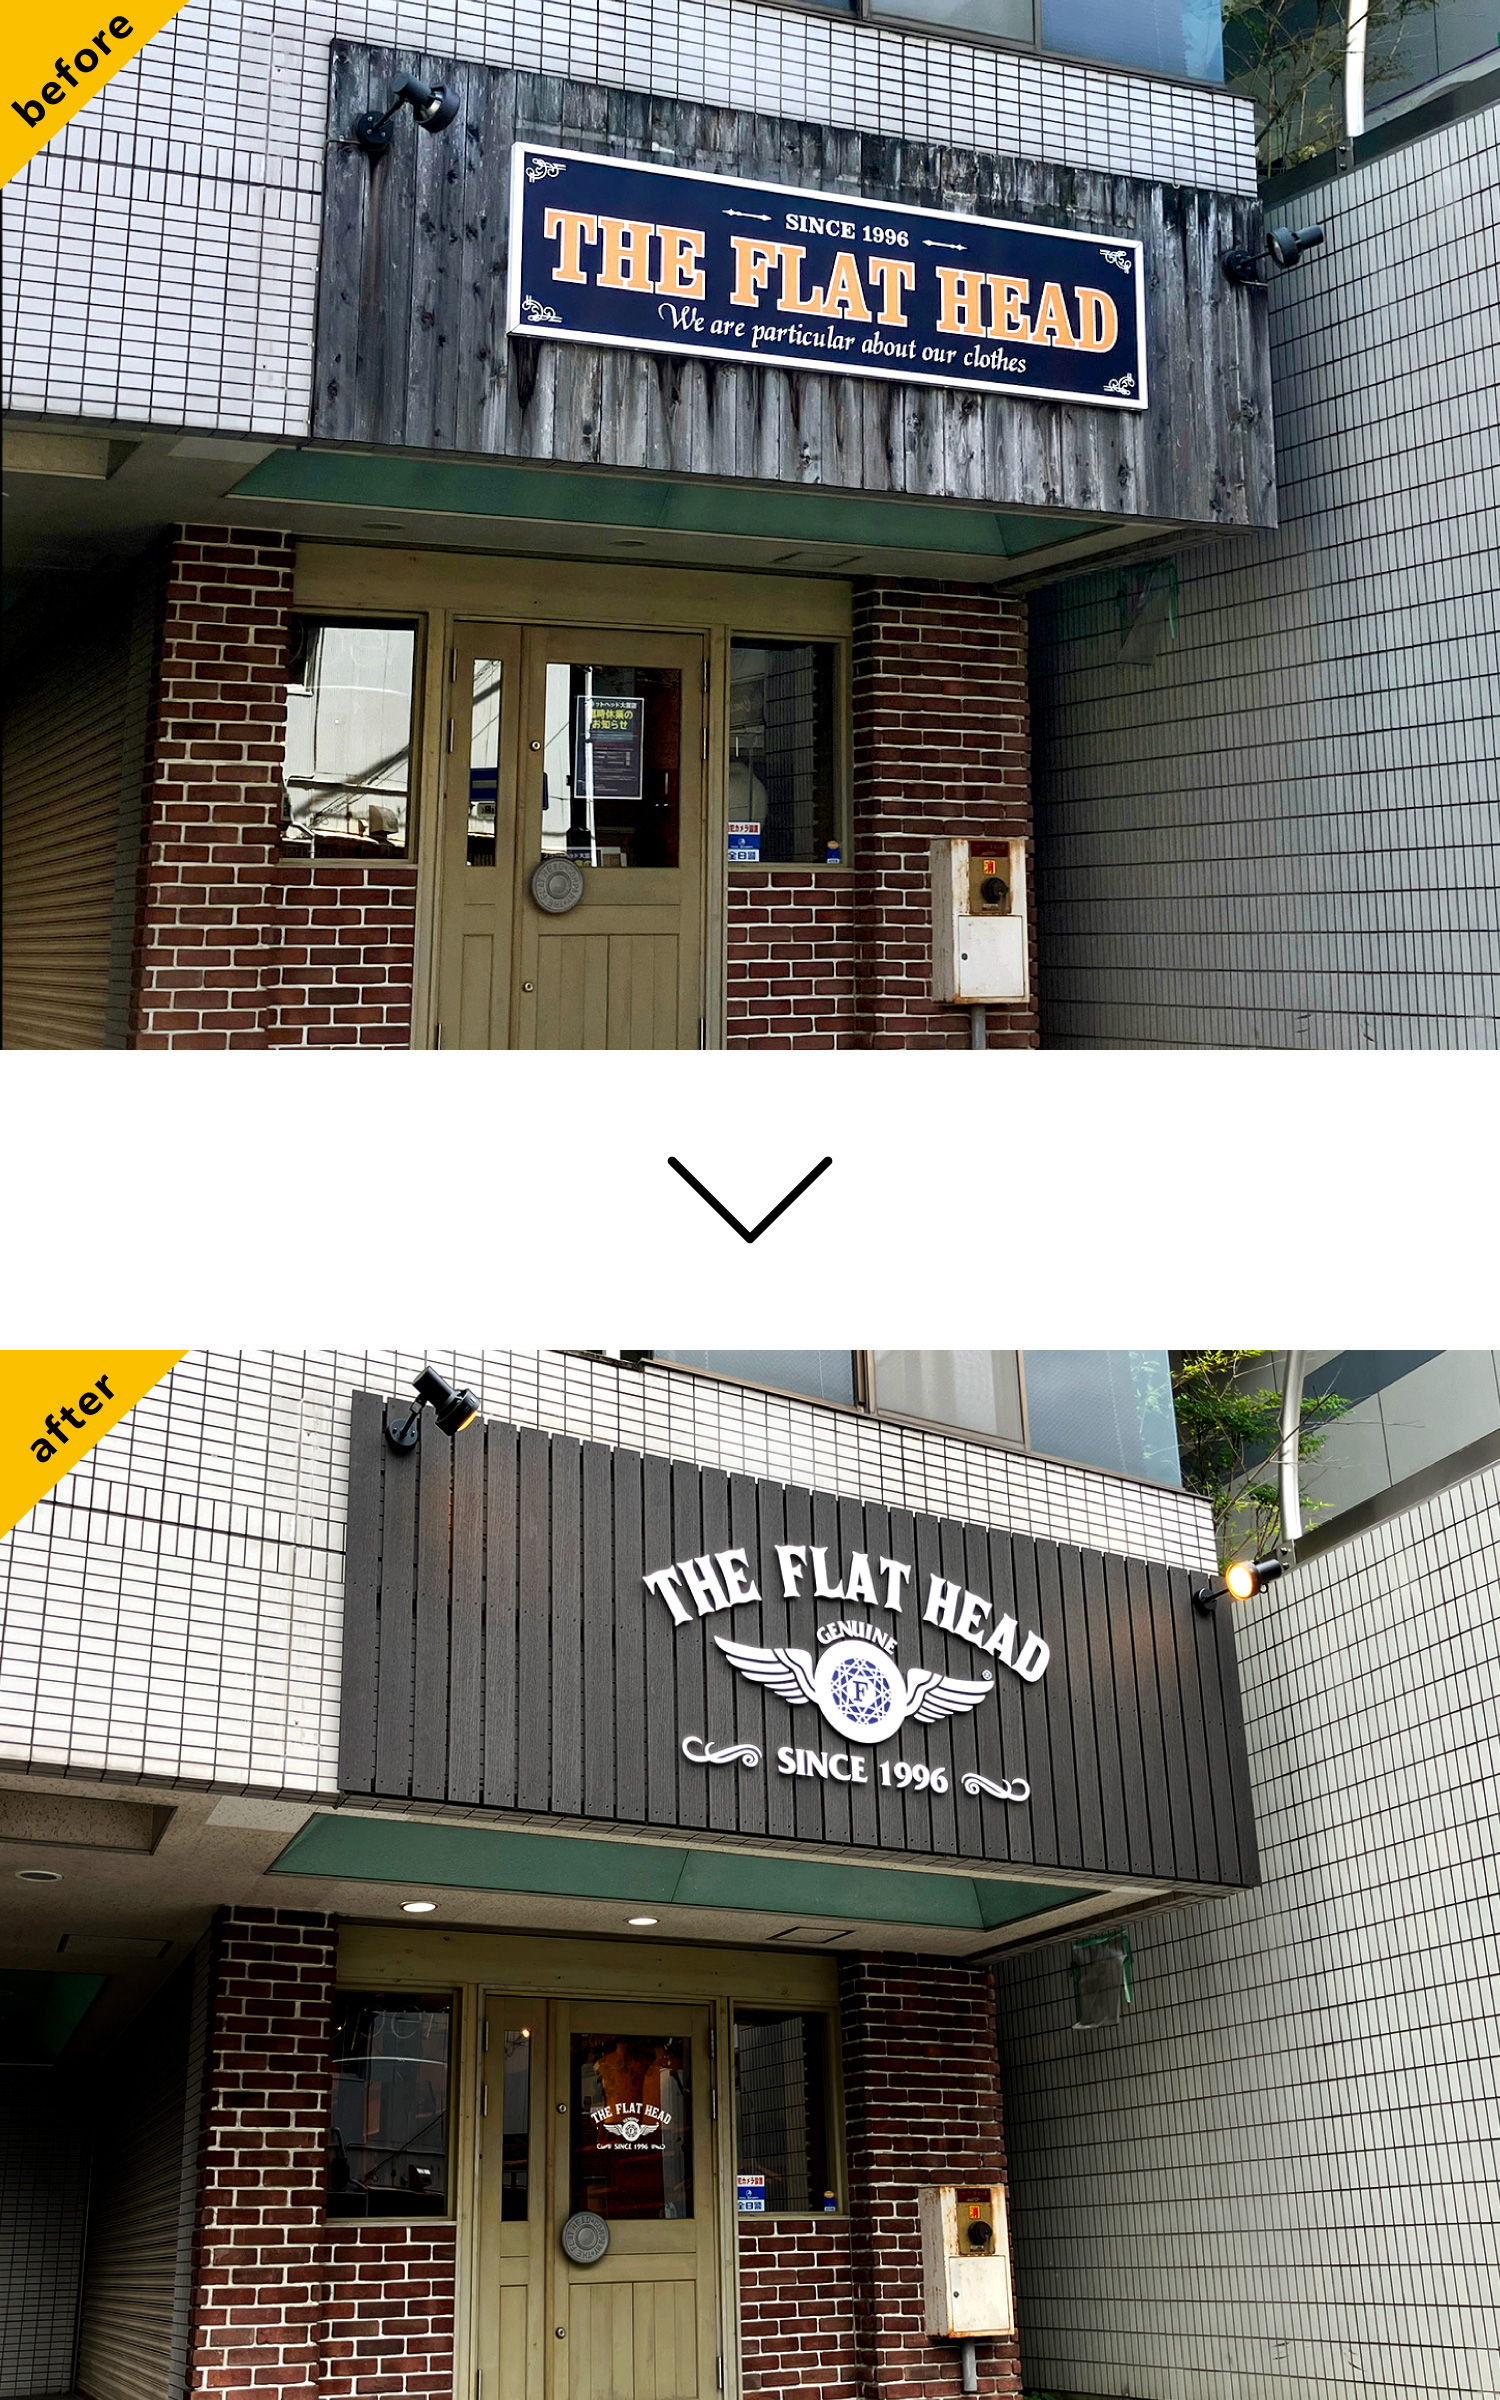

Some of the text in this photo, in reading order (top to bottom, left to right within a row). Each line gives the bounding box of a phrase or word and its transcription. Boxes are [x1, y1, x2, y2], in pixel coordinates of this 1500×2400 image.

[785, 213, 911, 249] SINCE 1996
[543, 206, 1119, 355] THE FLAT HEAD
[658, 302, 1028, 374] We are particular about our clothes
[592, 720, 628, 730] お知らせ
[642, 1544, 1051, 1683] THE FLAT HEAD
[816, 1619, 899, 1656] GENUINE
[852, 1679, 869, 1702] F
[777, 1746, 949, 1794] SINCE 1996
[590, 2102, 672, 2125] THE FLAT HEAD
[575, 2249, 592, 2259] THE
[593, 2220, 606, 2255] COMPANY
